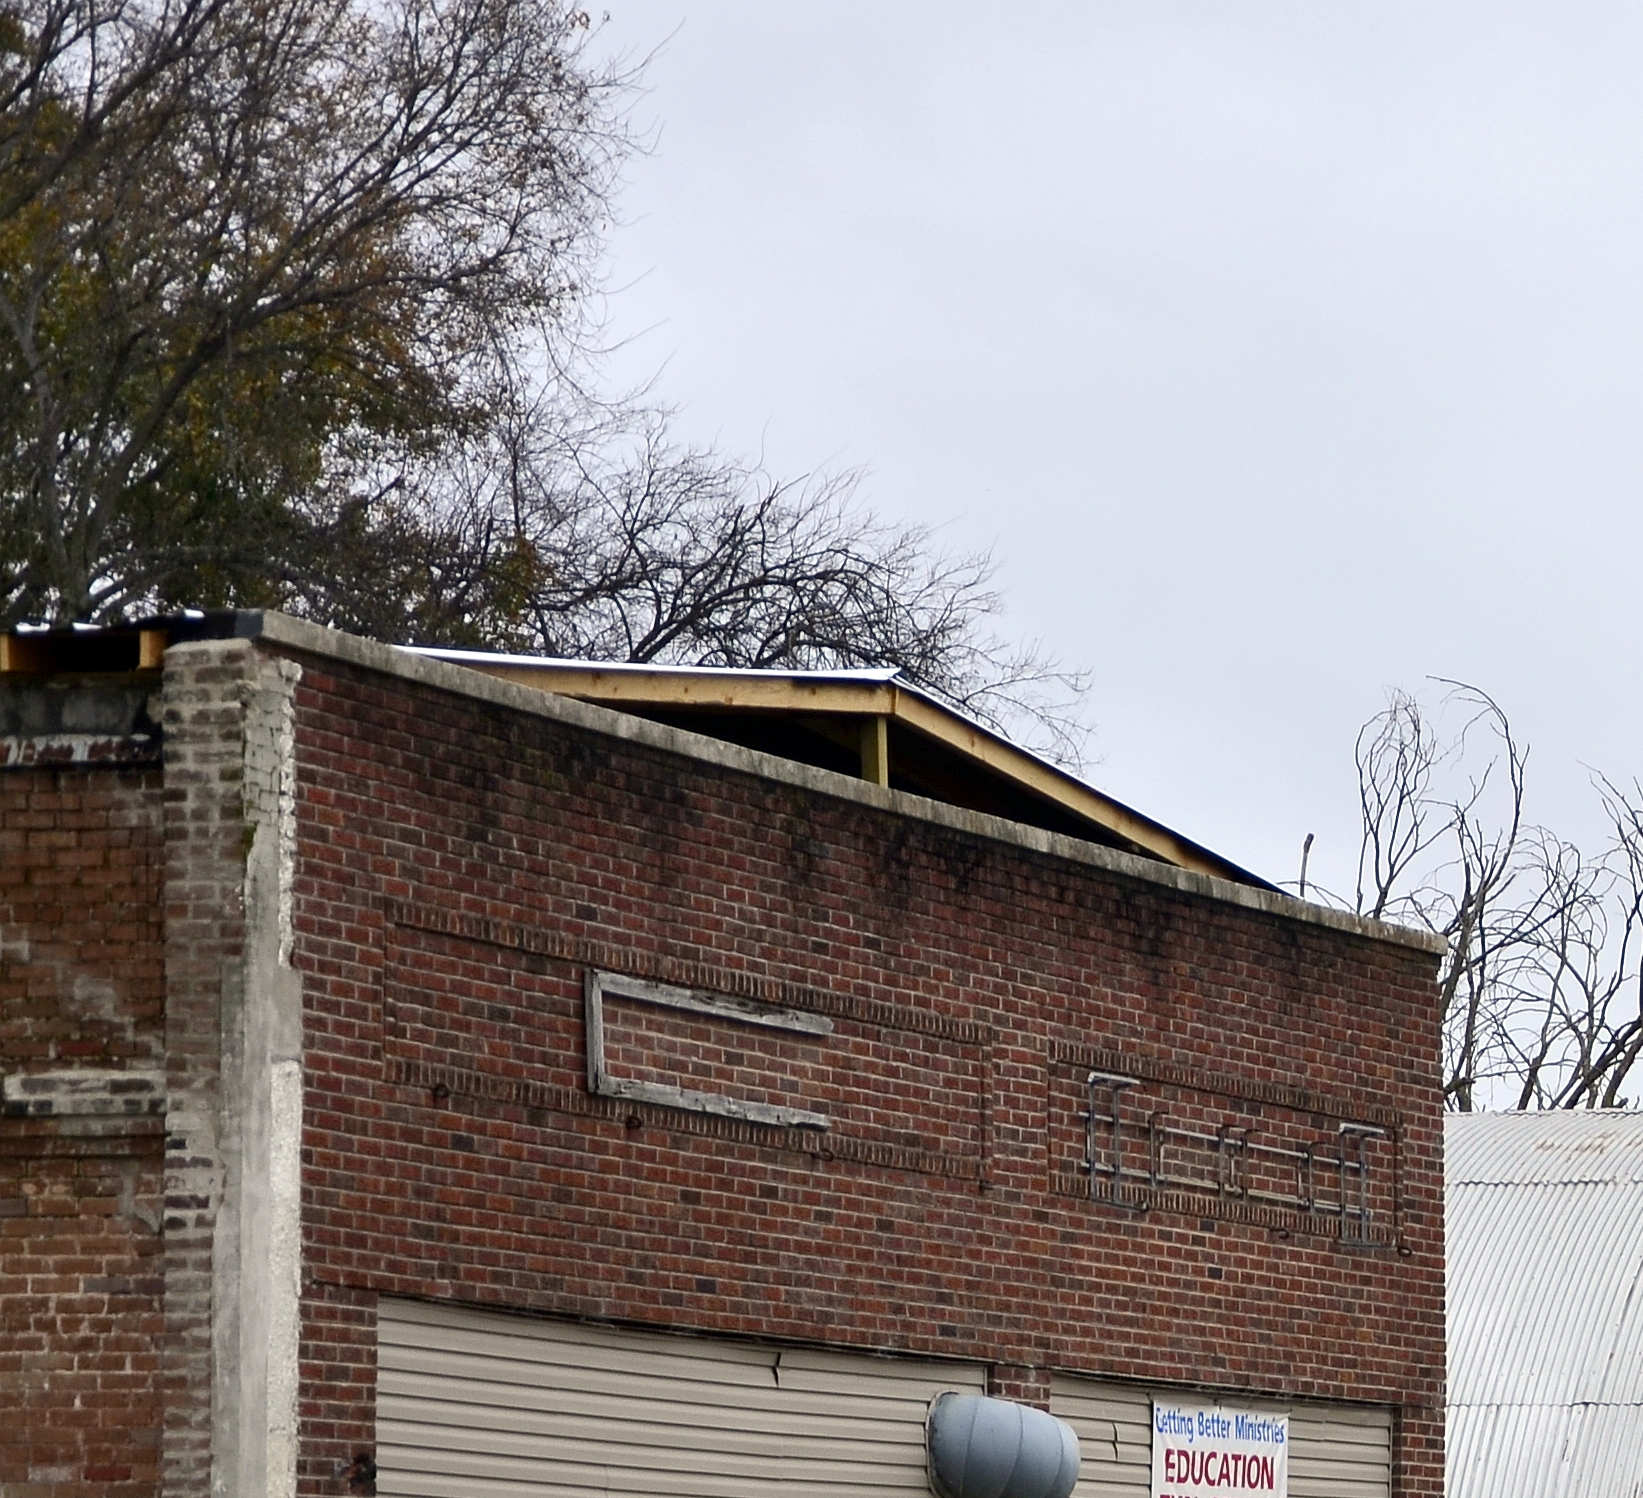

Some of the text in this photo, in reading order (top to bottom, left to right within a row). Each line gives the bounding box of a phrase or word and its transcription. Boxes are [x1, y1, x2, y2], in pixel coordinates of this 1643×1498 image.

[1155, 1407, 1285, 1444] Getting Better Ministries
[1164, 1448, 1275, 1490] EDUCATION
